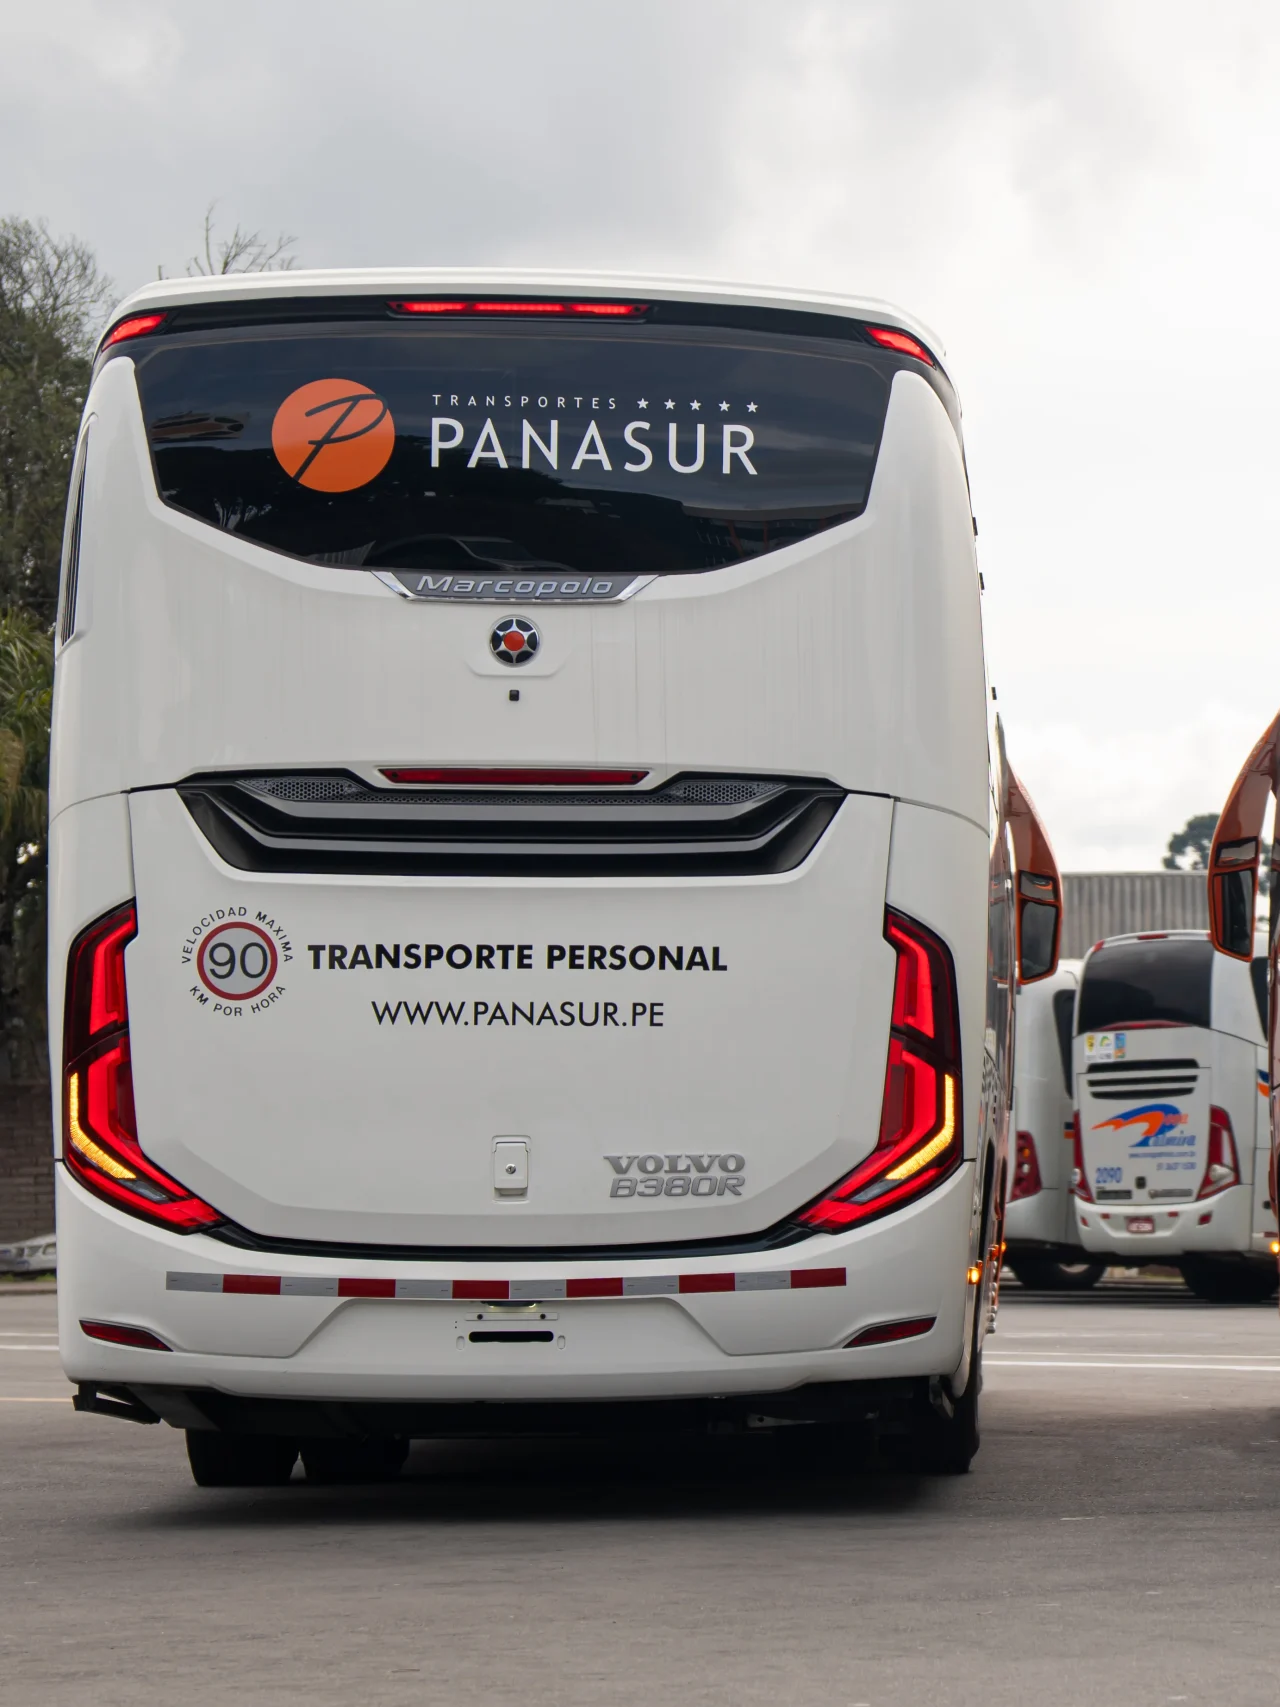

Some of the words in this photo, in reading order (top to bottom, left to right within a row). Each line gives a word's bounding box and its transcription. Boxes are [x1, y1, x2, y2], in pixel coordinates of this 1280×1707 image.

[432, 394, 616, 409] TRANSPORTES
[431, 417, 758, 475] PANASUR
[416, 575, 613, 597] Marcopolo
[181, 906, 247, 965] VELOCIDAD
[255, 911, 294, 963] MAXIMA
[208, 941, 268, 979] 90
[307, 943, 533, 970] TRANSPORTE
[546, 944, 728, 972] PERSONAL
[189, 985, 209, 1006] KM
[213, 1003, 243, 1017] POR
[250, 985, 287, 1014] HORA
[371, 1000, 664, 1027] WWW.PANASUR.PE
[603, 1153, 746, 1175] VOLVO
[609, 1175, 746, 1198] B380R
